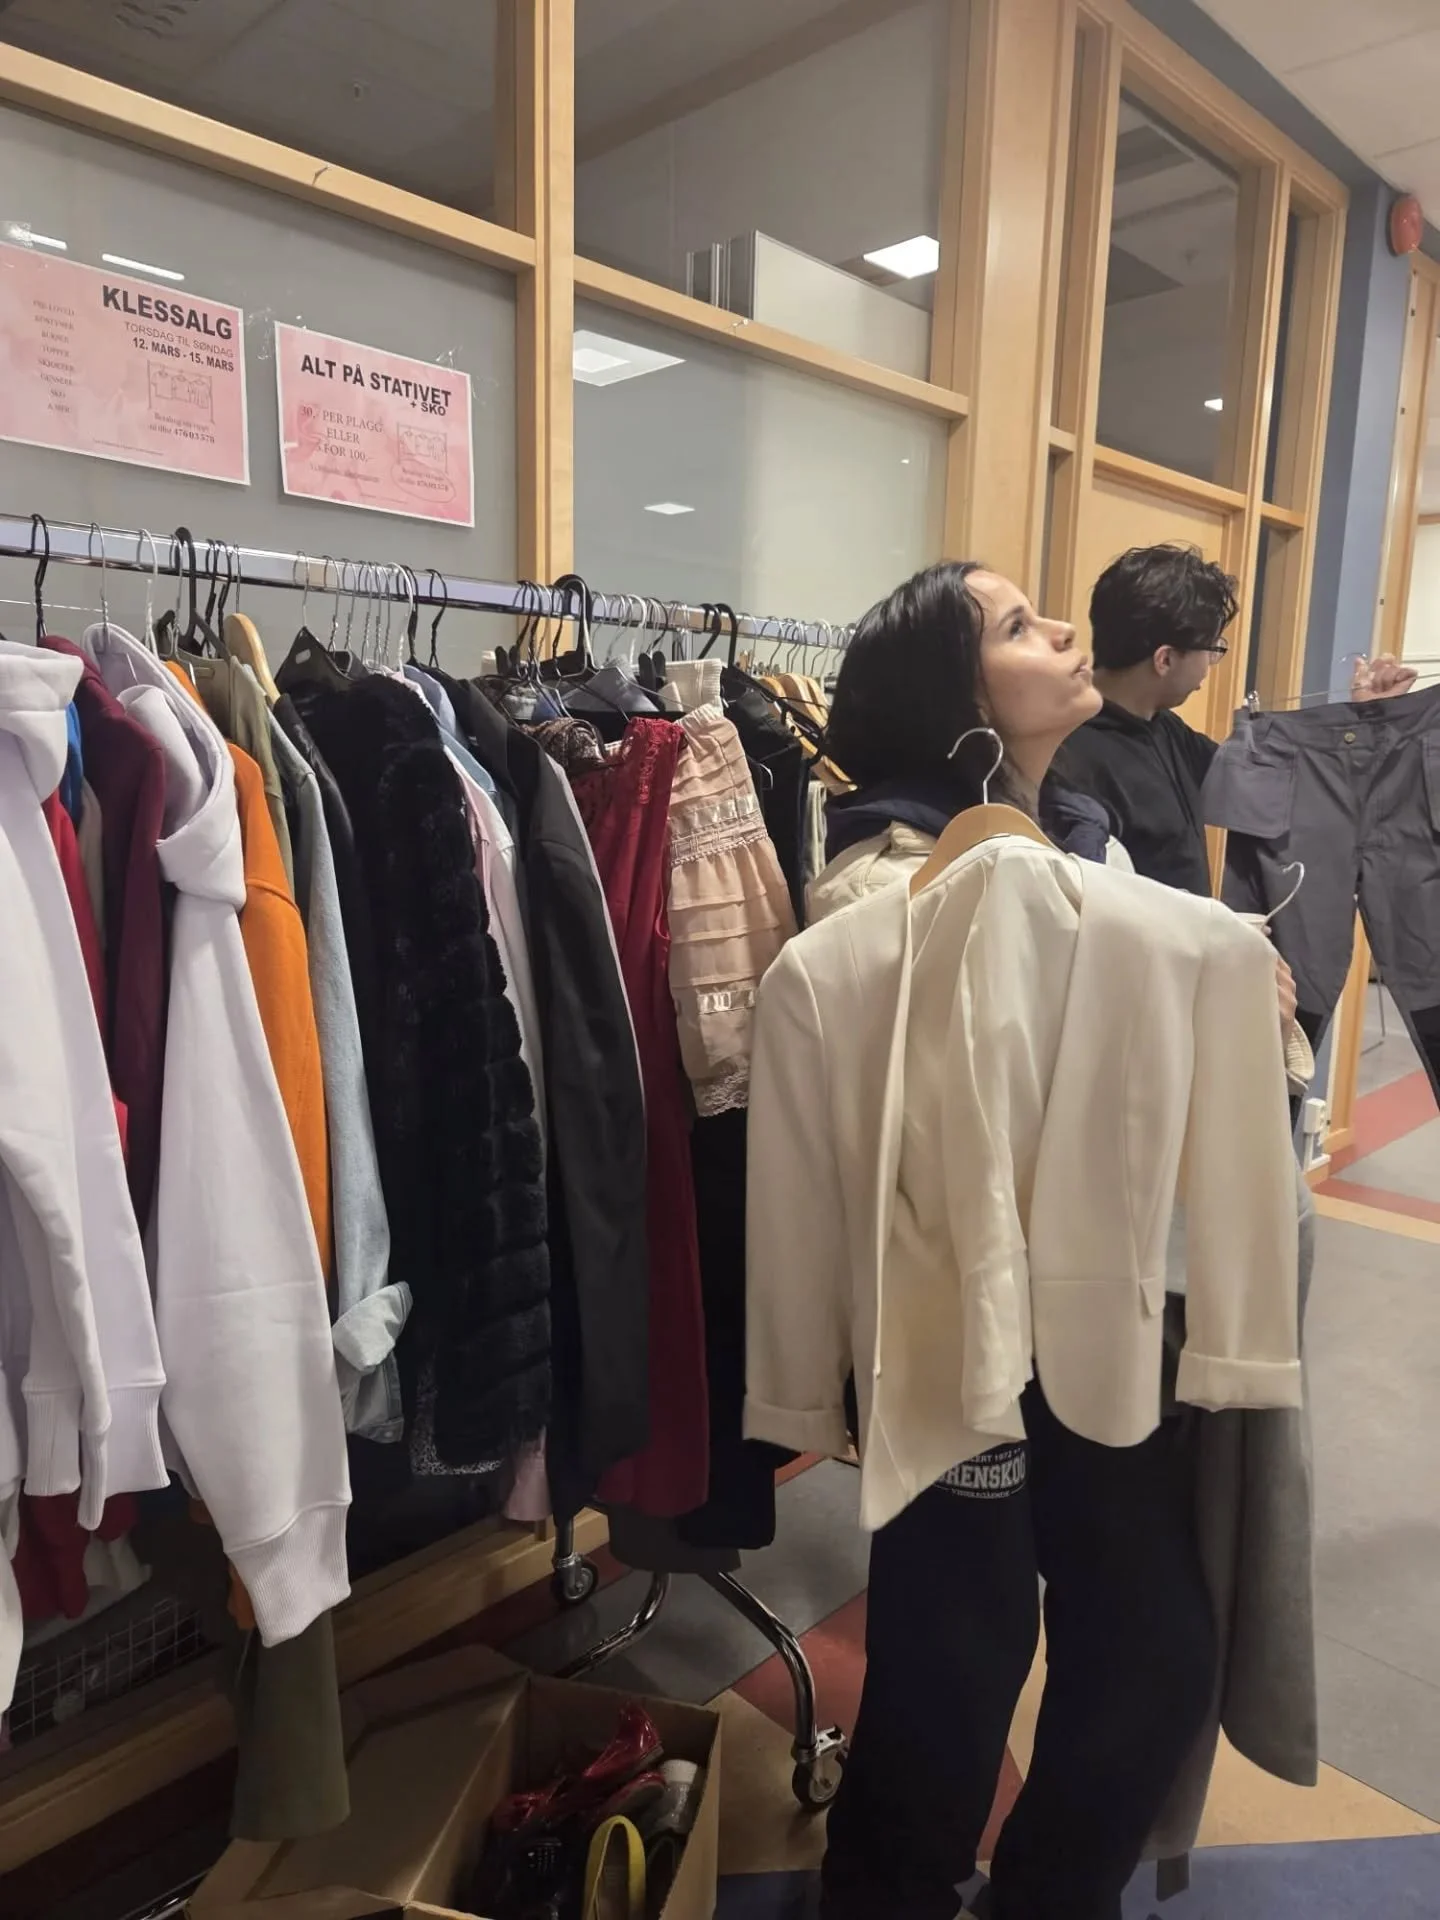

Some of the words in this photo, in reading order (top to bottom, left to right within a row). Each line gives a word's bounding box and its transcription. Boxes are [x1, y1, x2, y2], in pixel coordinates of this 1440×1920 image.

[102, 284, 233, 340] KLESSALG
[124, 321, 176, 343] TORSDAG
[176, 335, 191, 348] TIL
[192, 339, 234, 358] SØNDAG
[132, 337, 148, 351] 12.
[151, 341, 181, 359] MARS
[189, 352, 204, 365] 15.
[206, 355, 235, 372] MARS
[301, 354, 337, 380] ALT
[343, 363, 365, 387] PÅ
[370, 372, 452, 407] STATIVET
[323, 410, 344, 425] PER
[346, 415, 384, 433] PLAGG
[410, 401, 417, 409] +
[420, 402, 446, 417] SKO
[324, 443, 346, 457] FOR
[326, 427, 360, 445] ELLER
